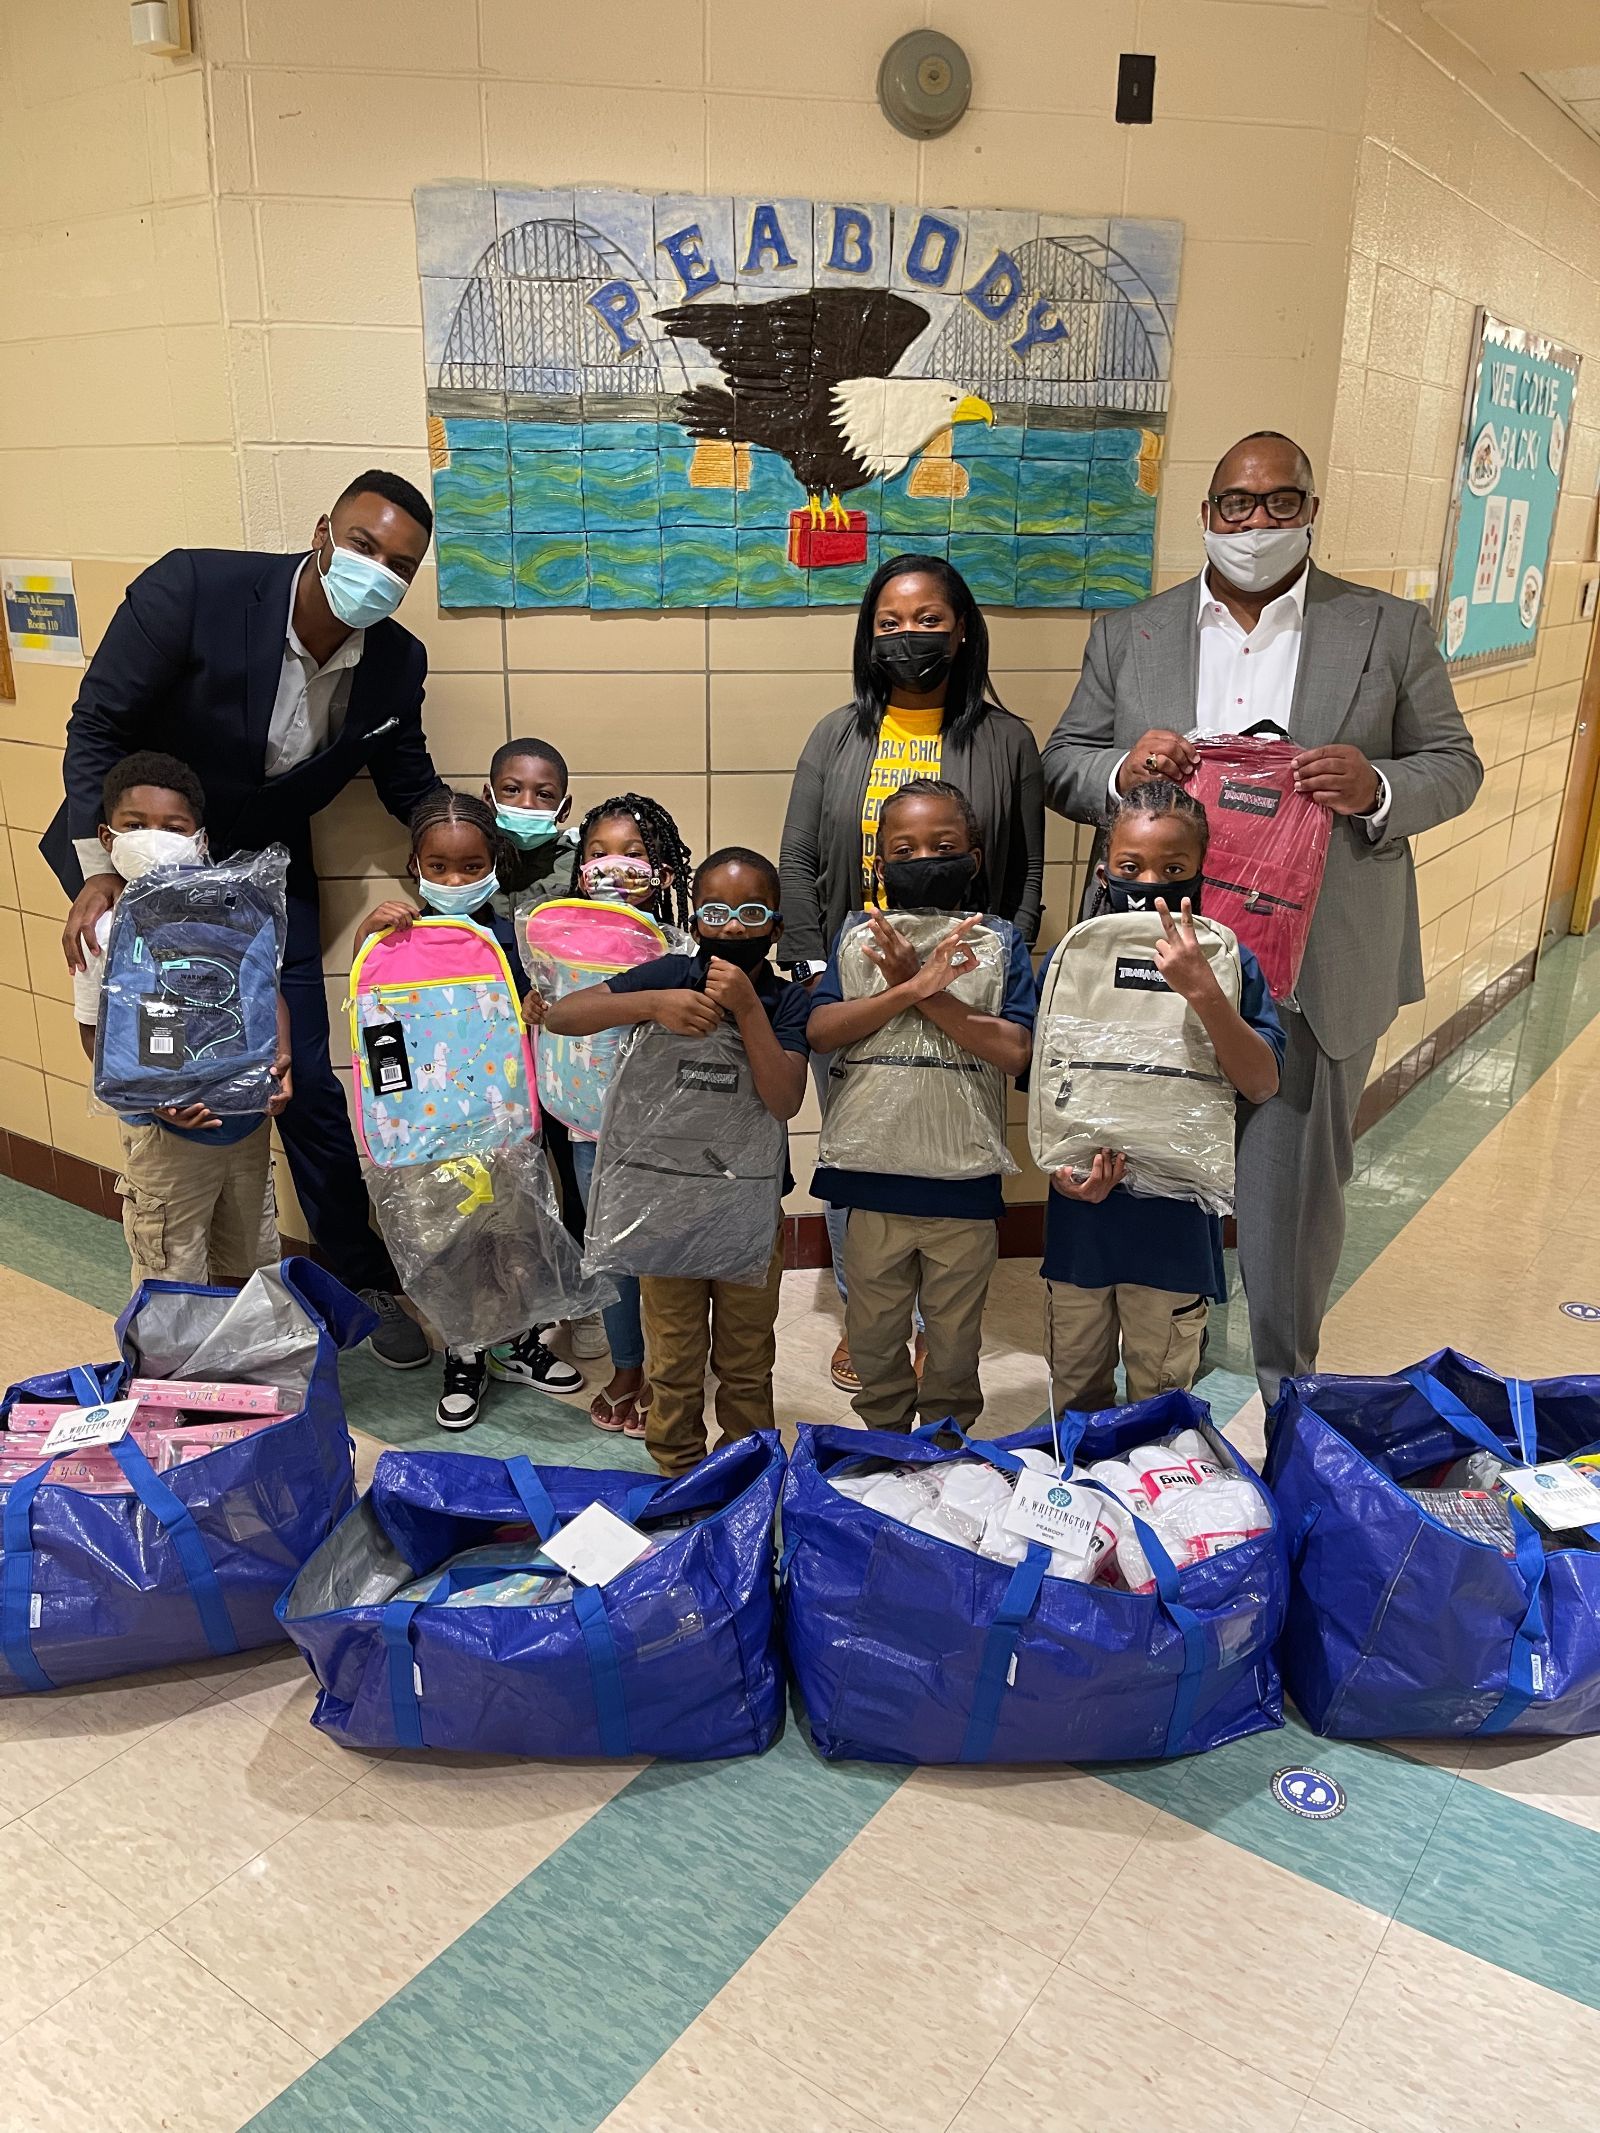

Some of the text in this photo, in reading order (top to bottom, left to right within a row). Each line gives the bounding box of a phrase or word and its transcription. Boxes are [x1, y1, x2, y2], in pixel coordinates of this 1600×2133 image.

[585, 204, 1069, 363] PEABODY
[1491, 361, 1560, 419] WELCOME
[1500, 425, 1541, 481] BACK!
[27, 619, 46, 630] Room
[876, 739, 906, 759] RLY
[1031, 1501, 1092, 1531] WHITTINGTON
[1035, 1523, 1065, 1537] PEABODY
